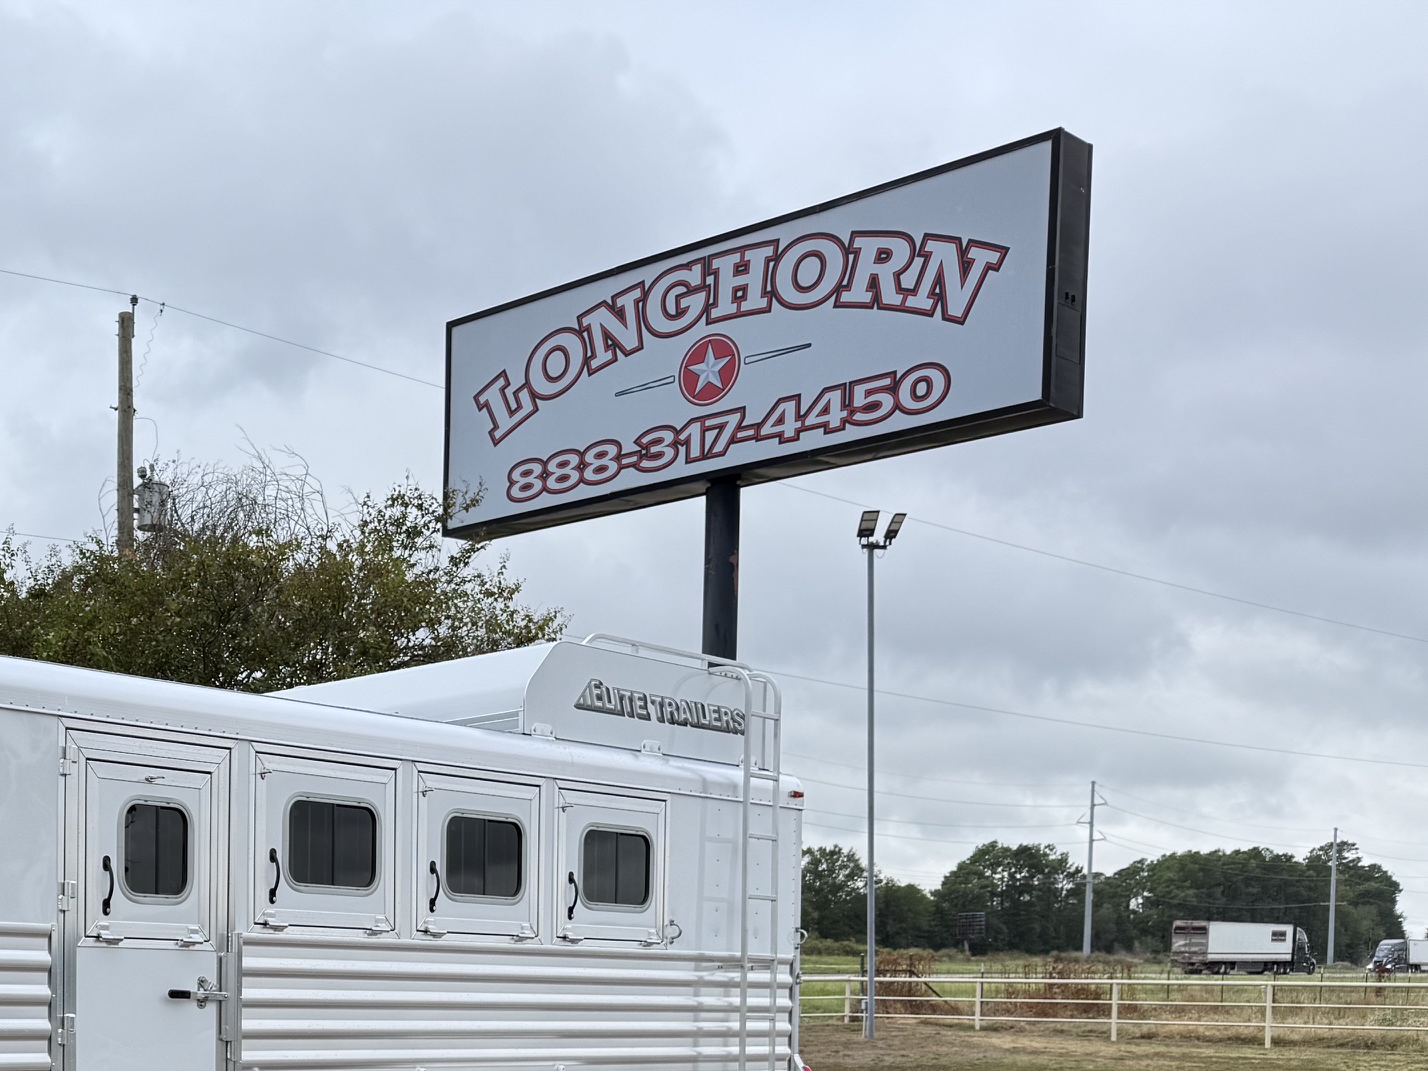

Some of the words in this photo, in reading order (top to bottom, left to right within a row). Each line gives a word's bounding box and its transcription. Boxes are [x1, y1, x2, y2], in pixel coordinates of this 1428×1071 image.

[474, 230, 1010, 446] LONGHORN
[506, 362, 951, 502] 888-317-4450
[574, 678, 651, 721] ELITE
[649, 694, 746, 735] TRAILERS
